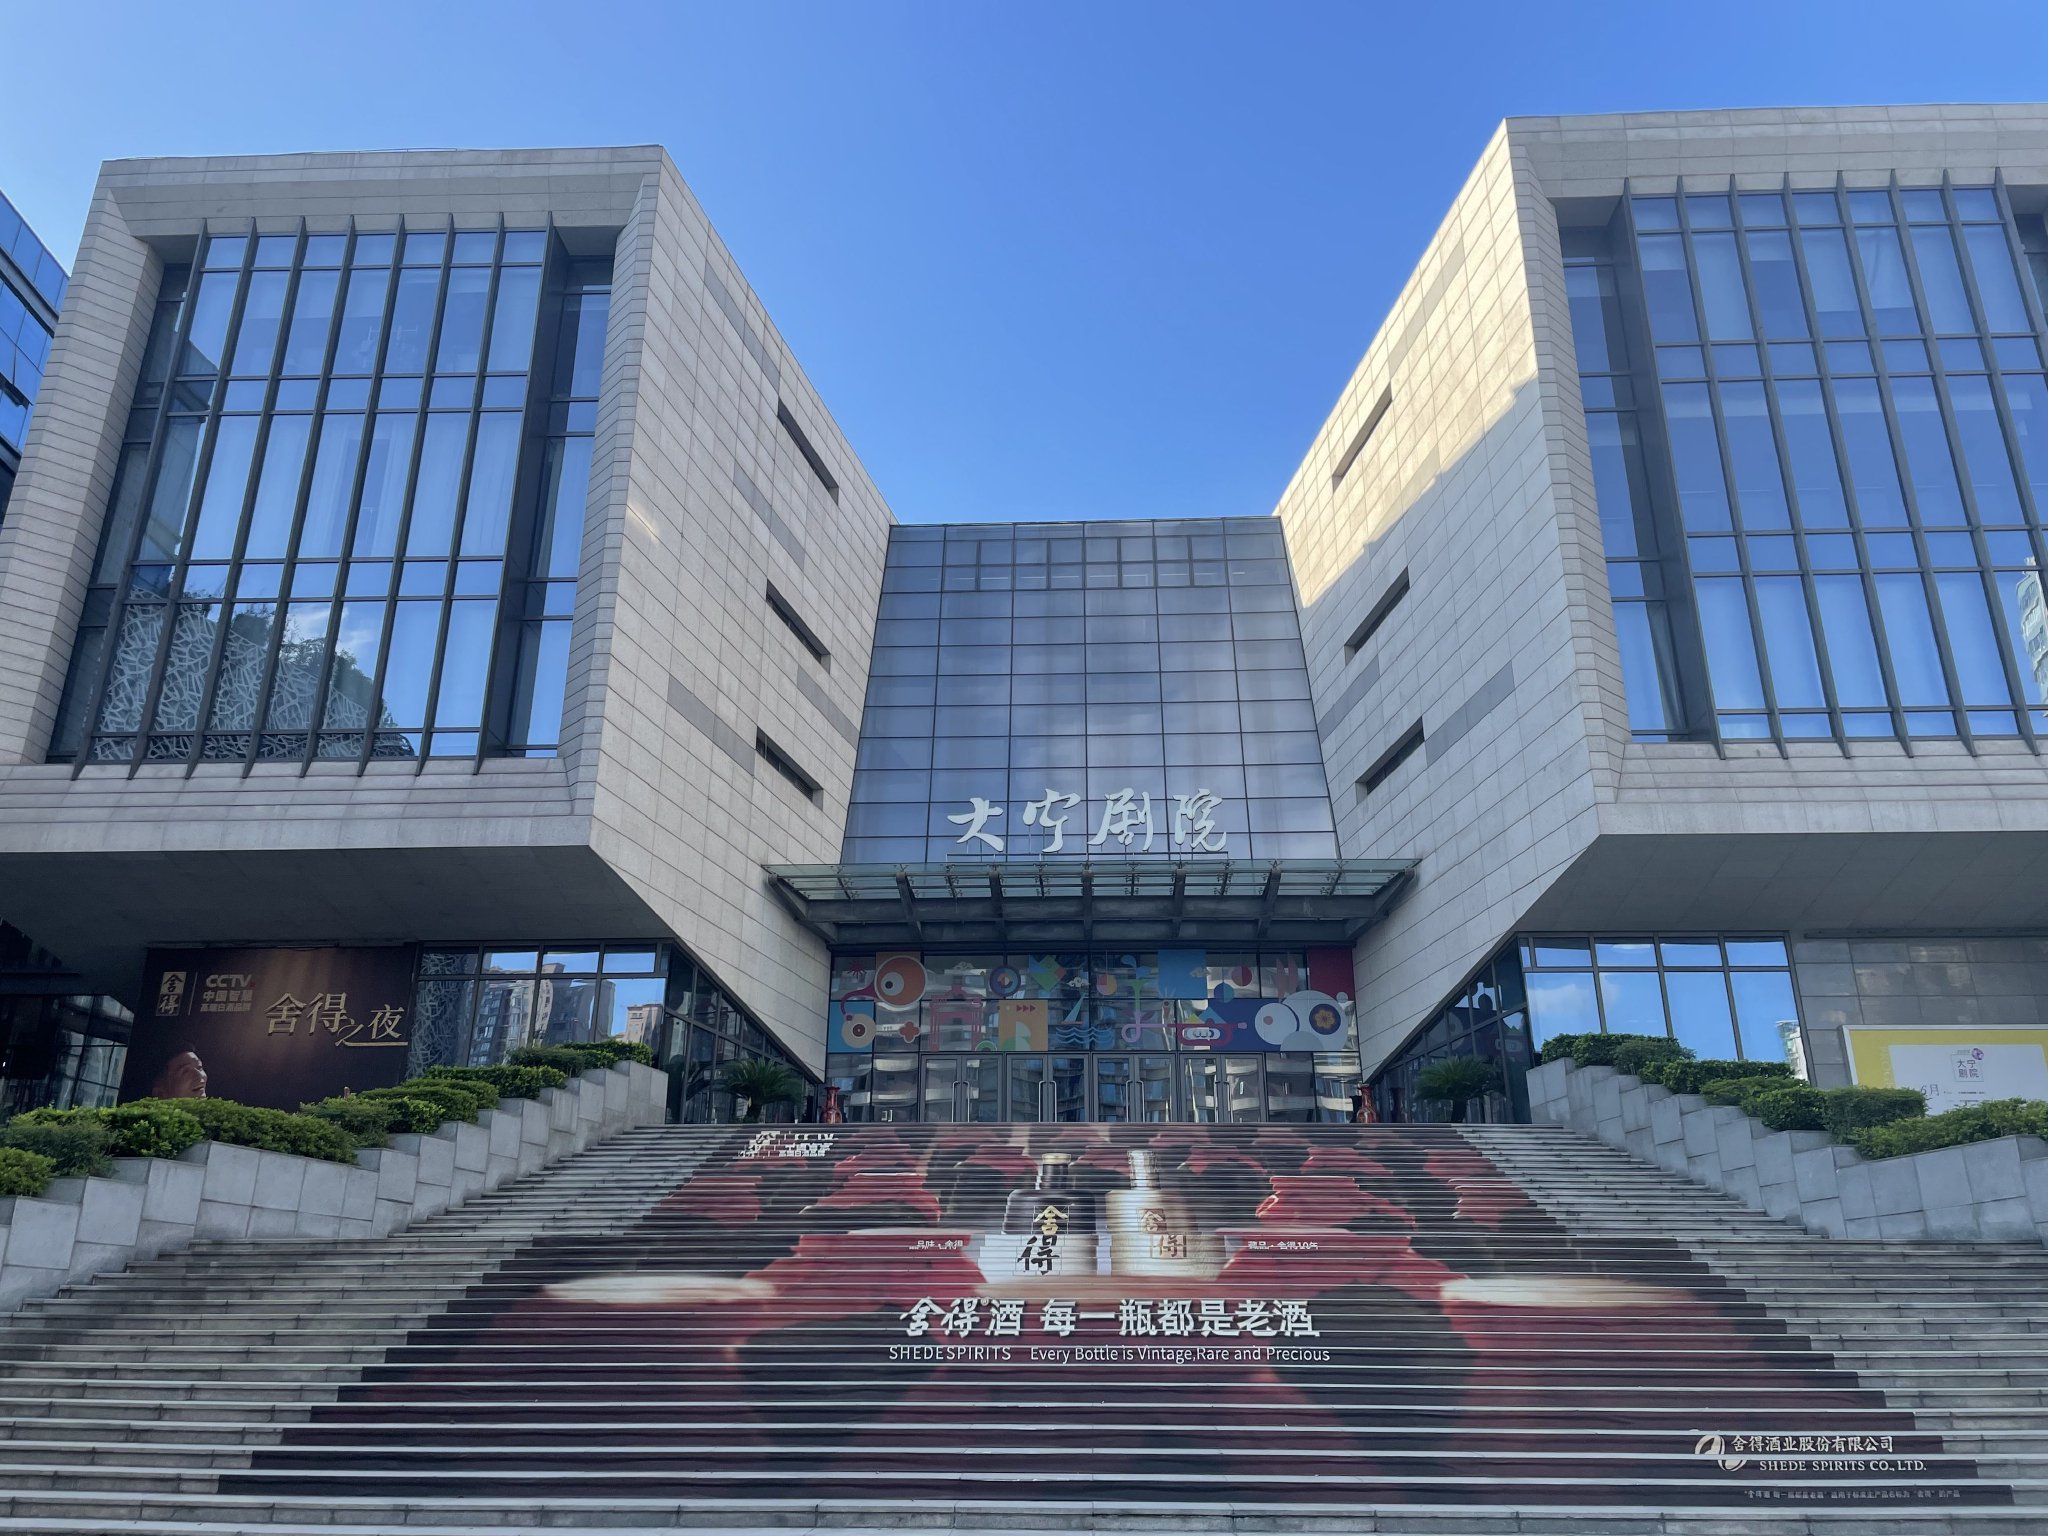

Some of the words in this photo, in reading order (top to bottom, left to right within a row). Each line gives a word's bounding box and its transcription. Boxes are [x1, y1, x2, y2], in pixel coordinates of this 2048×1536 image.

[947, 787, 1227, 852] 大宁剧院
[158, 974, 184, 1014] 舍得
[206, 974, 252, 988] CCTV
[264, 992, 408, 1047] 舍得之夜
[1017, 1205, 1069, 1276] 舍得
[1040, 1298, 1320, 1338] 每一瓶都是老酒
[1030, 1346, 1070, 1364] Every
[1075, 1344, 1118, 1361] Bottle
[1122, 1344, 1134, 1361] is
[1234, 1345, 1261, 1361] and
[1267, 1346, 1330, 1362] Precious
[1731, 1435, 1893, 1453] 舍得酒业股份有限公司
[1759, 1460, 1807, 1471] SHEDE
[1812, 1460, 1865, 1471] SPIRITS
